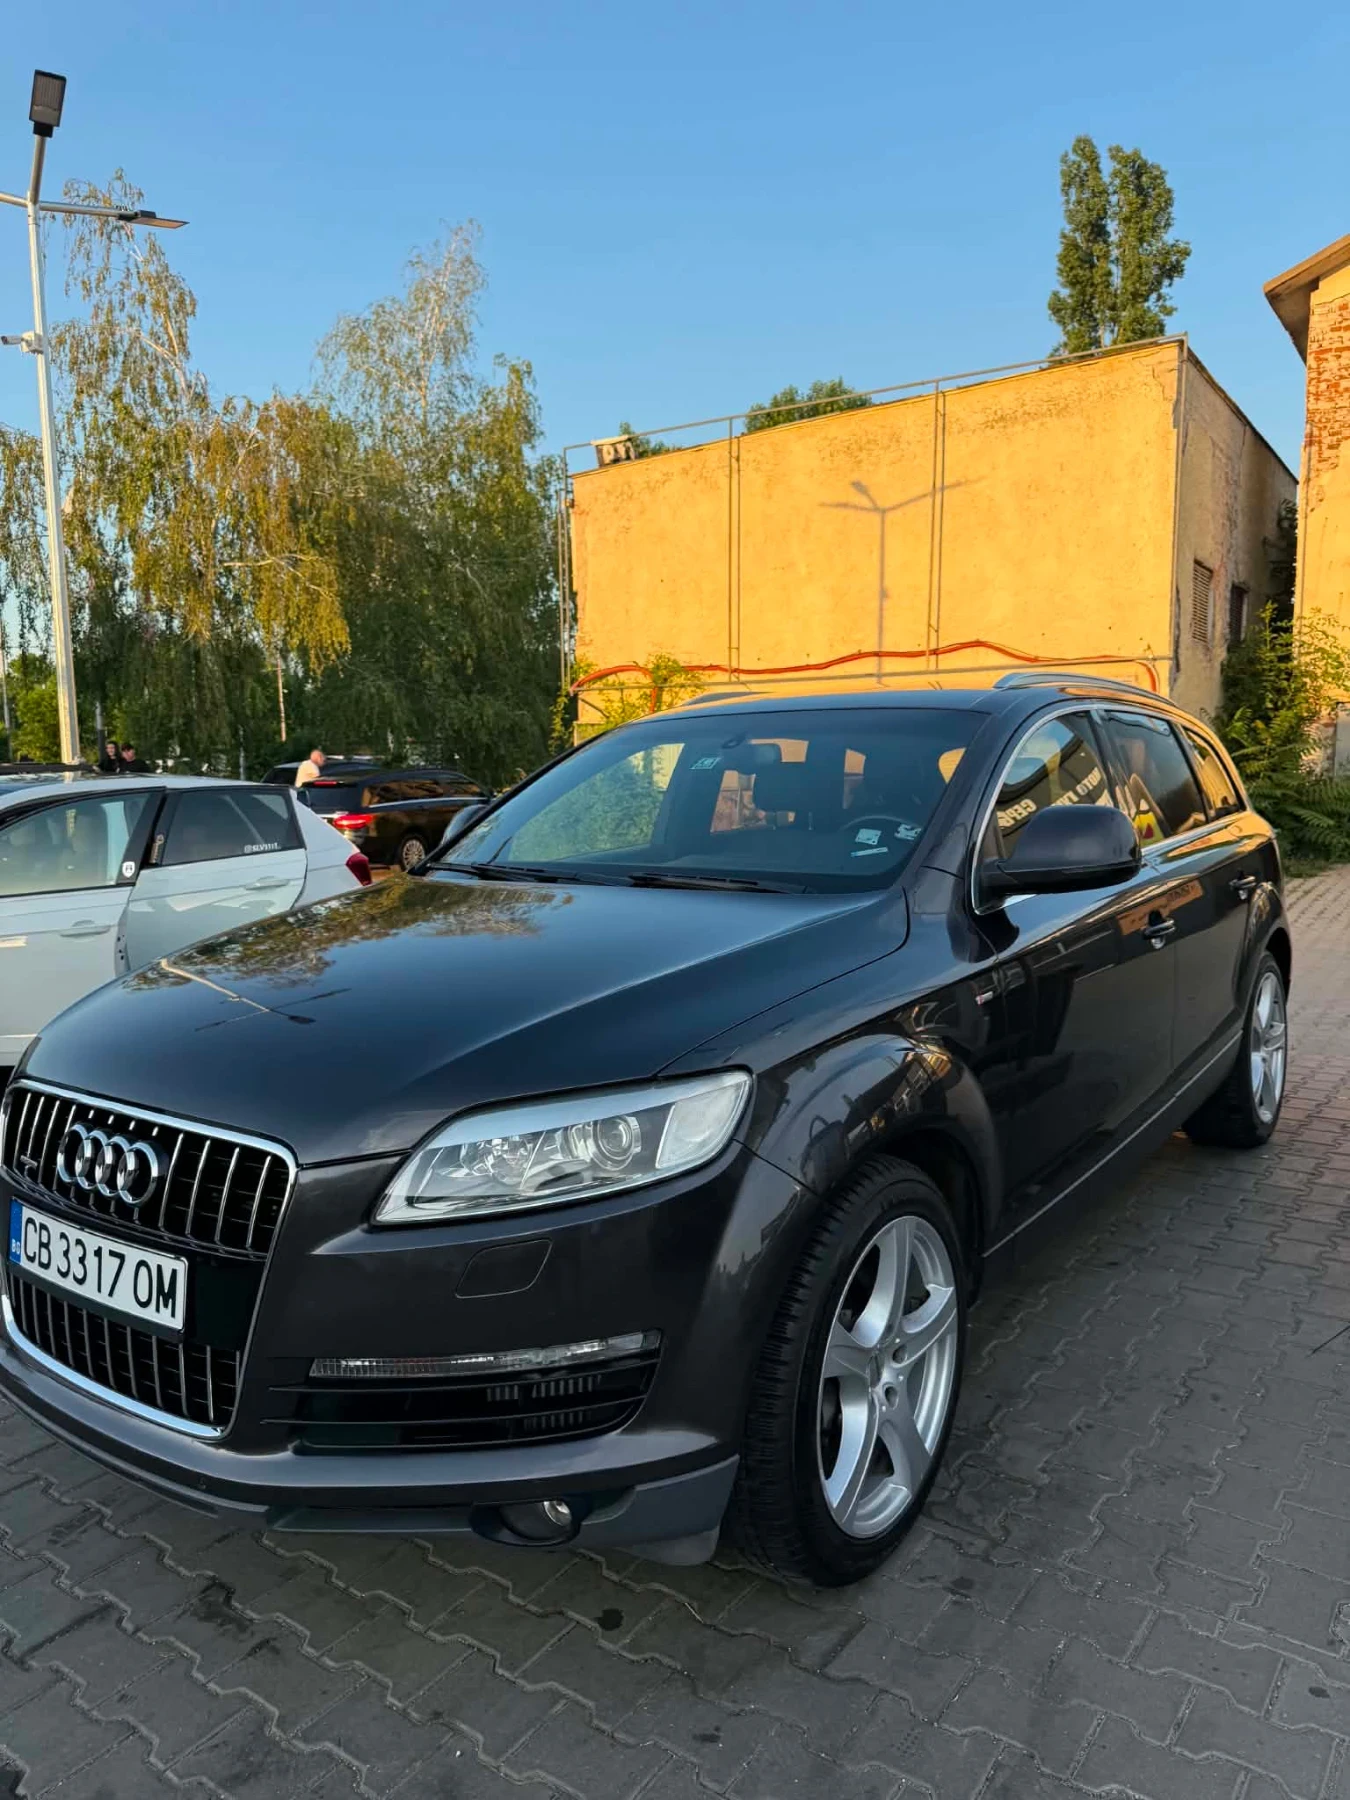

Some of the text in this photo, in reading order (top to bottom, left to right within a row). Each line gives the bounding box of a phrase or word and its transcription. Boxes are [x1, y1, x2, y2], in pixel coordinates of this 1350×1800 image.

[24, 1217, 177, 1318] CB 3317 OM
